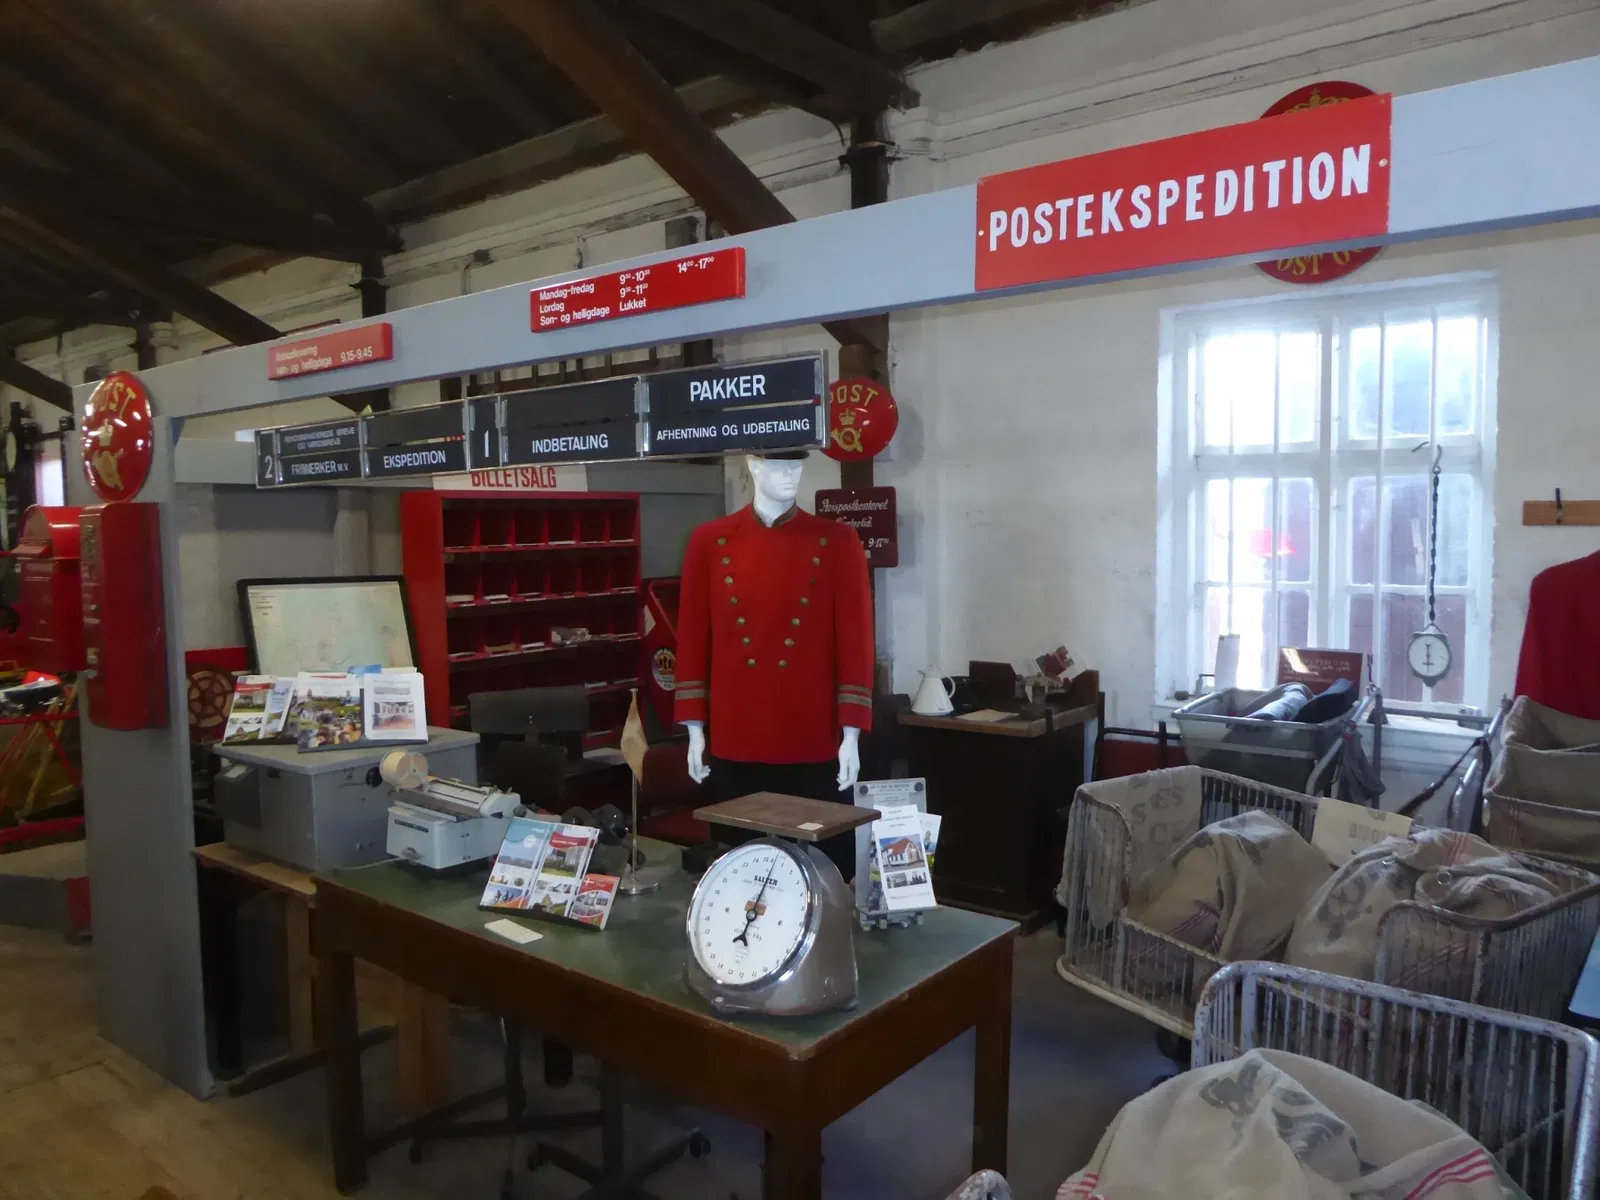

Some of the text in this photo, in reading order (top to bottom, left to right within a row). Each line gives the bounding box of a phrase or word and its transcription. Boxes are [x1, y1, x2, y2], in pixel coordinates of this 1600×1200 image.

[989, 144, 1371, 252] POSTEKSPEDITION
[540, 282, 594, 301] Mandag-fredag
[560, 314, 570, 324] og
[572, 306, 610, 320] helligdage
[620, 298, 646, 312] Lukket
[690, 374, 766, 402] PAKKER
[656, 418, 810, 441] AFHENTNING OG UDBETALING
[532, 433, 608, 454] INDBETALING
[264, 455, 272, 479] 2
[384, 450, 446, 468] EKSPEDITION
[471, 466, 556, 488] BILLETSALG
